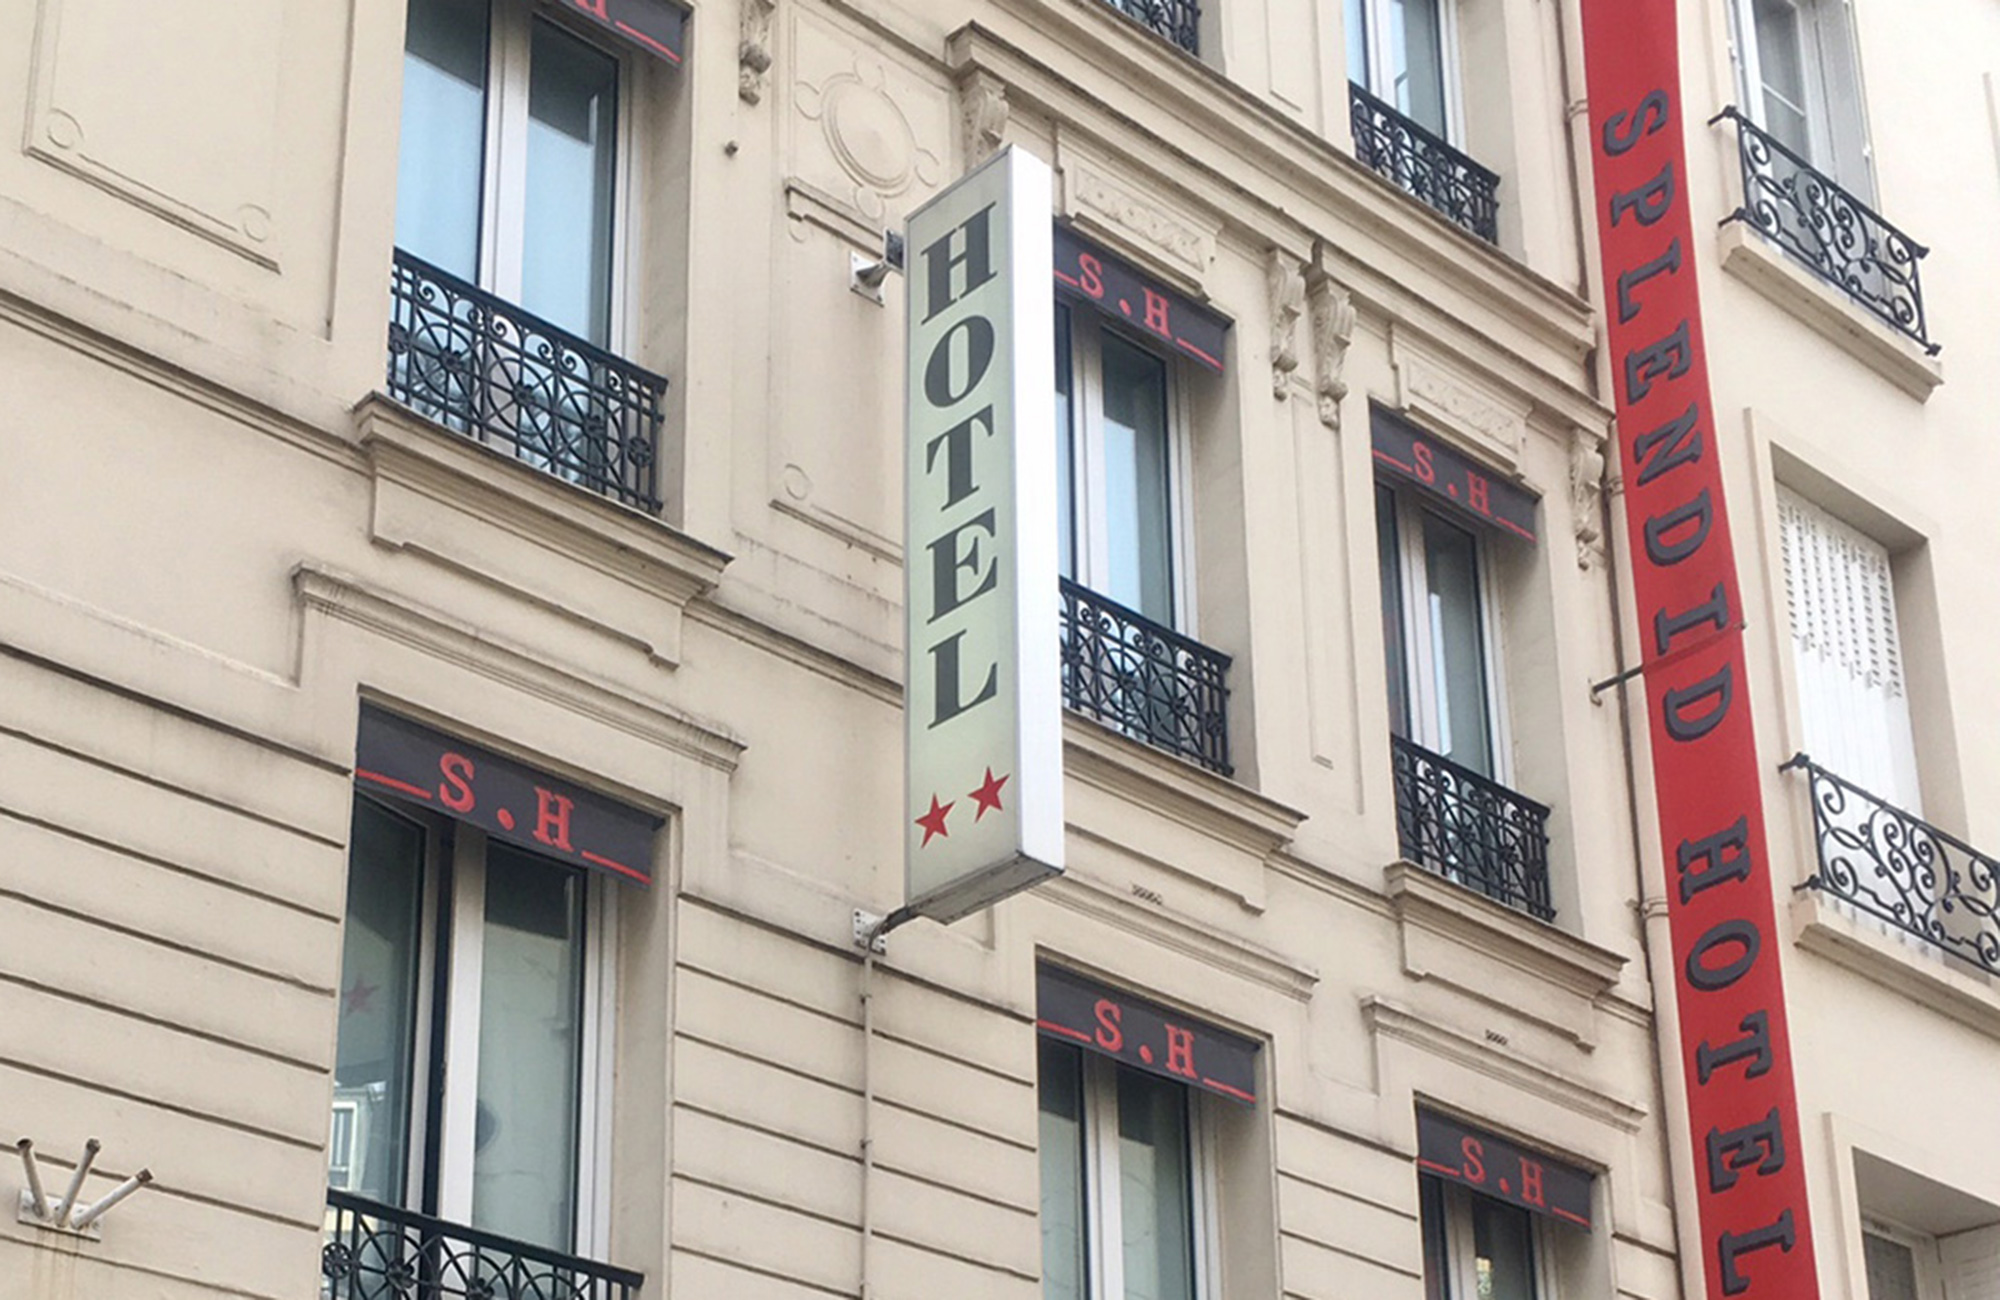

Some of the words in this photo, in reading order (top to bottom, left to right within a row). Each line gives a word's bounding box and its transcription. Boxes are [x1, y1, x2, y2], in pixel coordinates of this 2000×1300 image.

[920, 201, 998, 730] HOTEL
[1602, 88, 1733, 742] SPLENDID
[1676, 815, 1795, 1296] HOTEL
